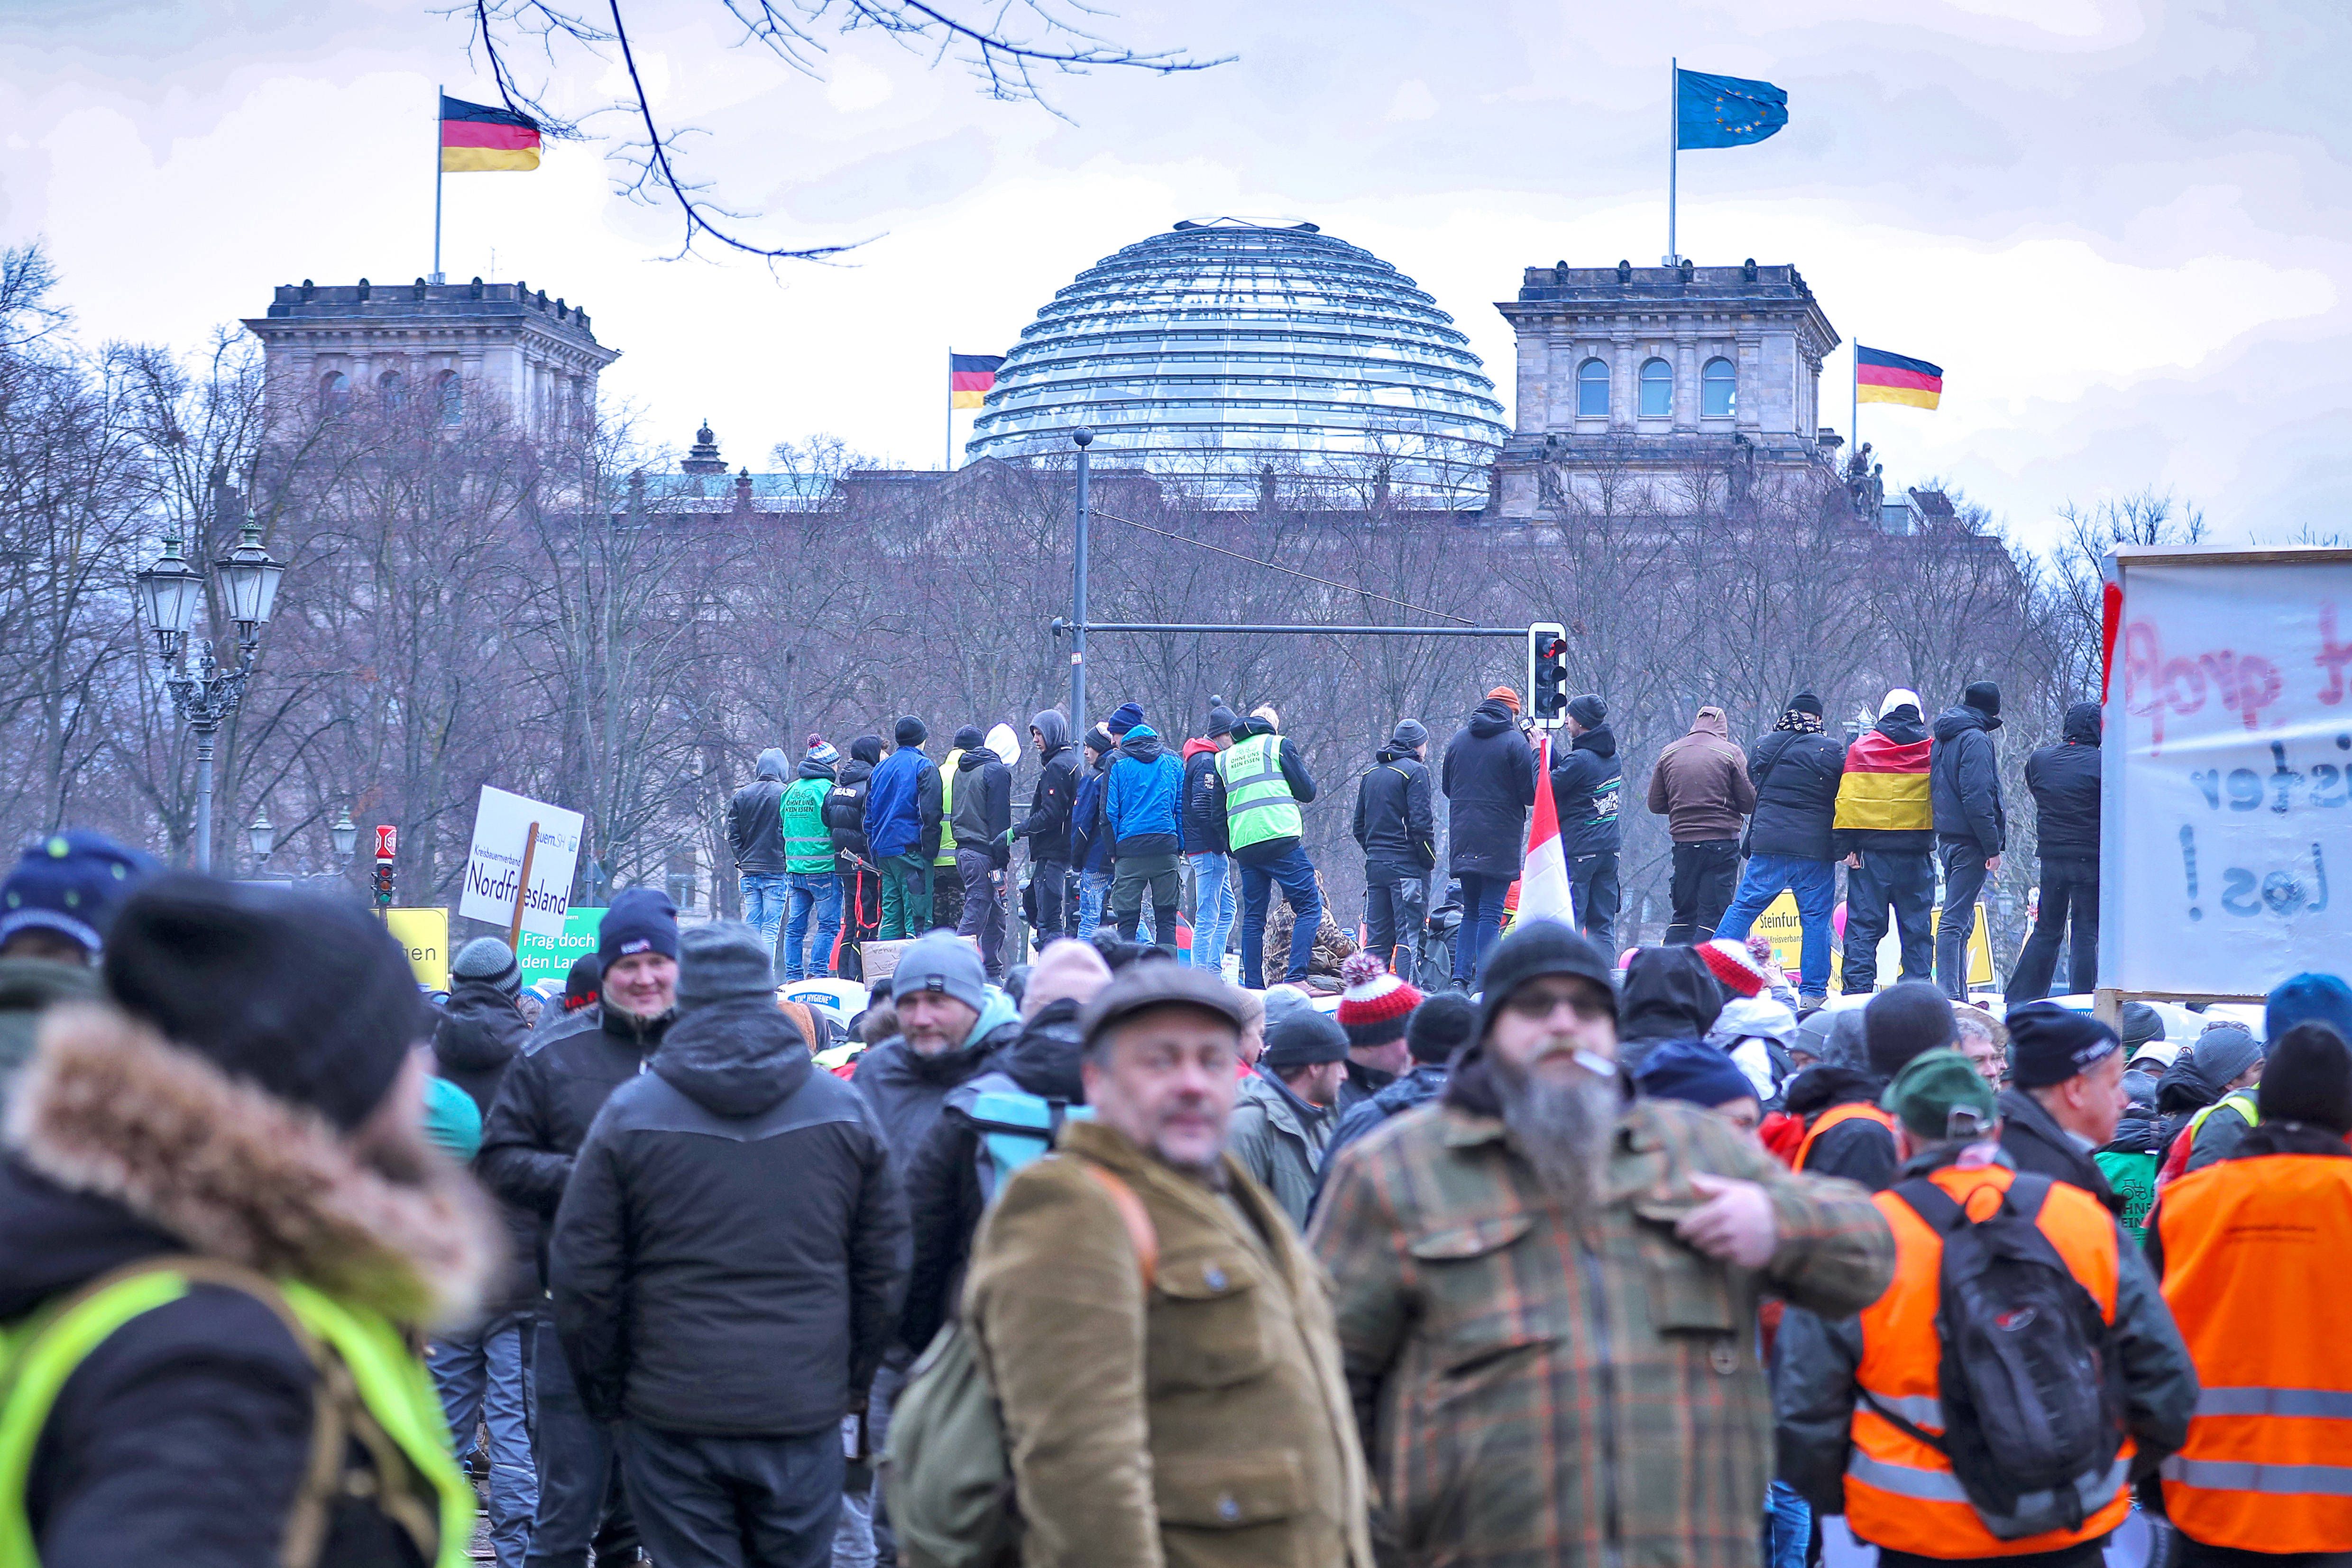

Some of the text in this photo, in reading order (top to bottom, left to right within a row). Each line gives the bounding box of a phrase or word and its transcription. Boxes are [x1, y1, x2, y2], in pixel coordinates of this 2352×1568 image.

[1231, 755, 1246, 763] OHNE
[474, 844, 522, 867] Kreisbauernverband
[467, 860, 569, 916] Nordfresland
[1760, 912, 1801, 928] Steinfur
[524, 933, 555, 950] Frag
[521, 954, 550, 969] den
